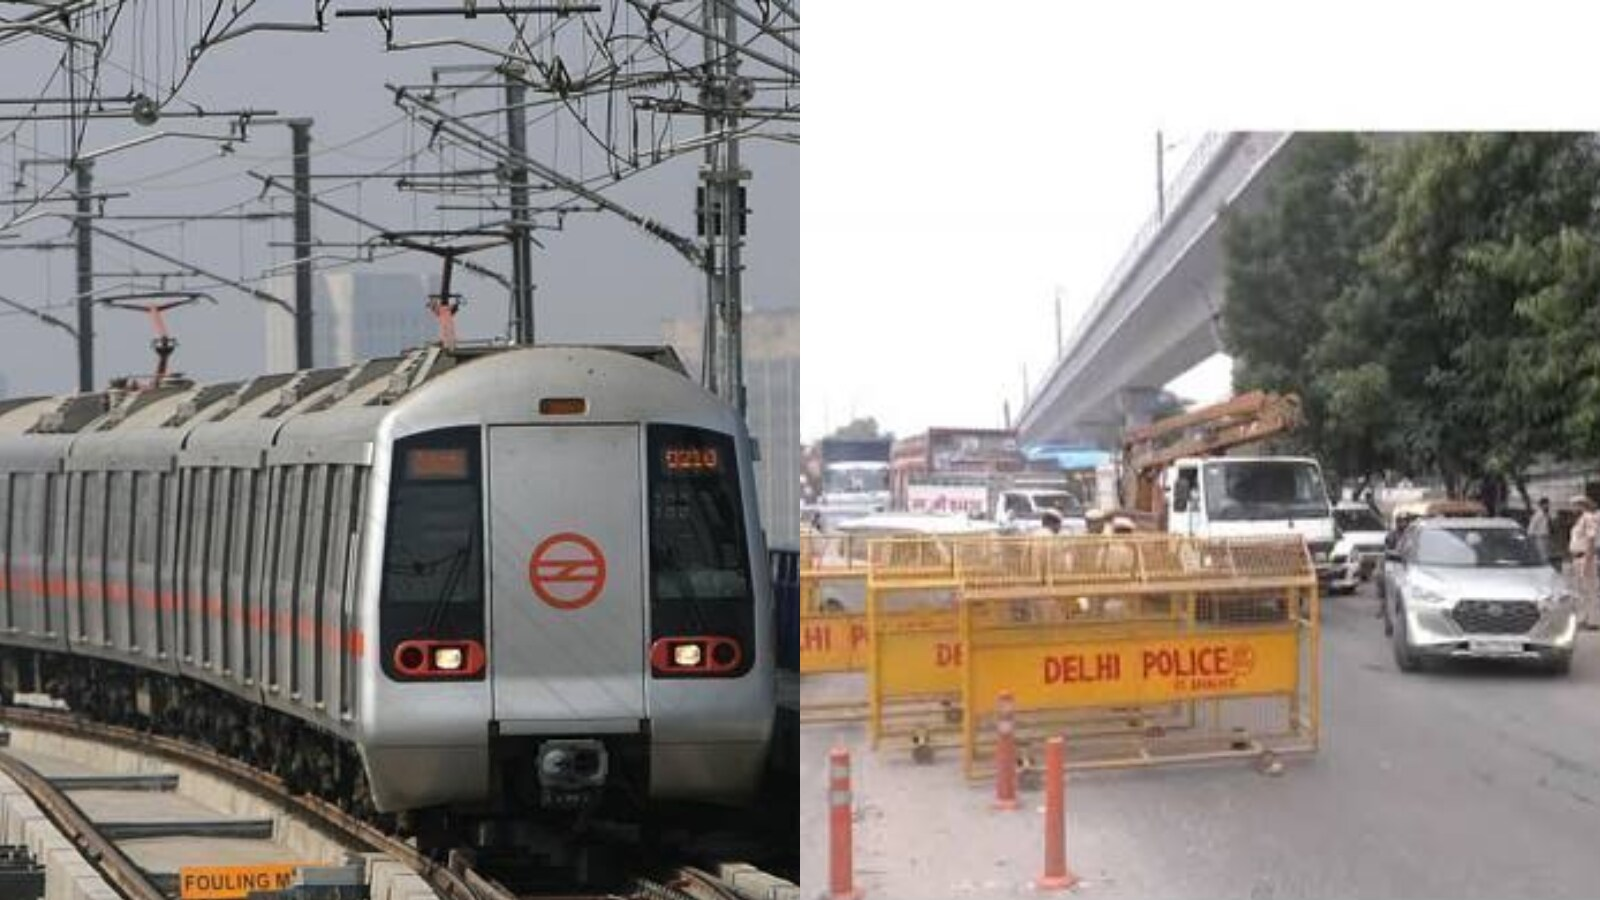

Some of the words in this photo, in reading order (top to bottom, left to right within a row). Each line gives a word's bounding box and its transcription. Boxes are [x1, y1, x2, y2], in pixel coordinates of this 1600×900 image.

[1044, 654, 1120, 685] DELHI
[1143, 647, 1228, 679] POLICE
[185, 873, 270, 891] FOULING
